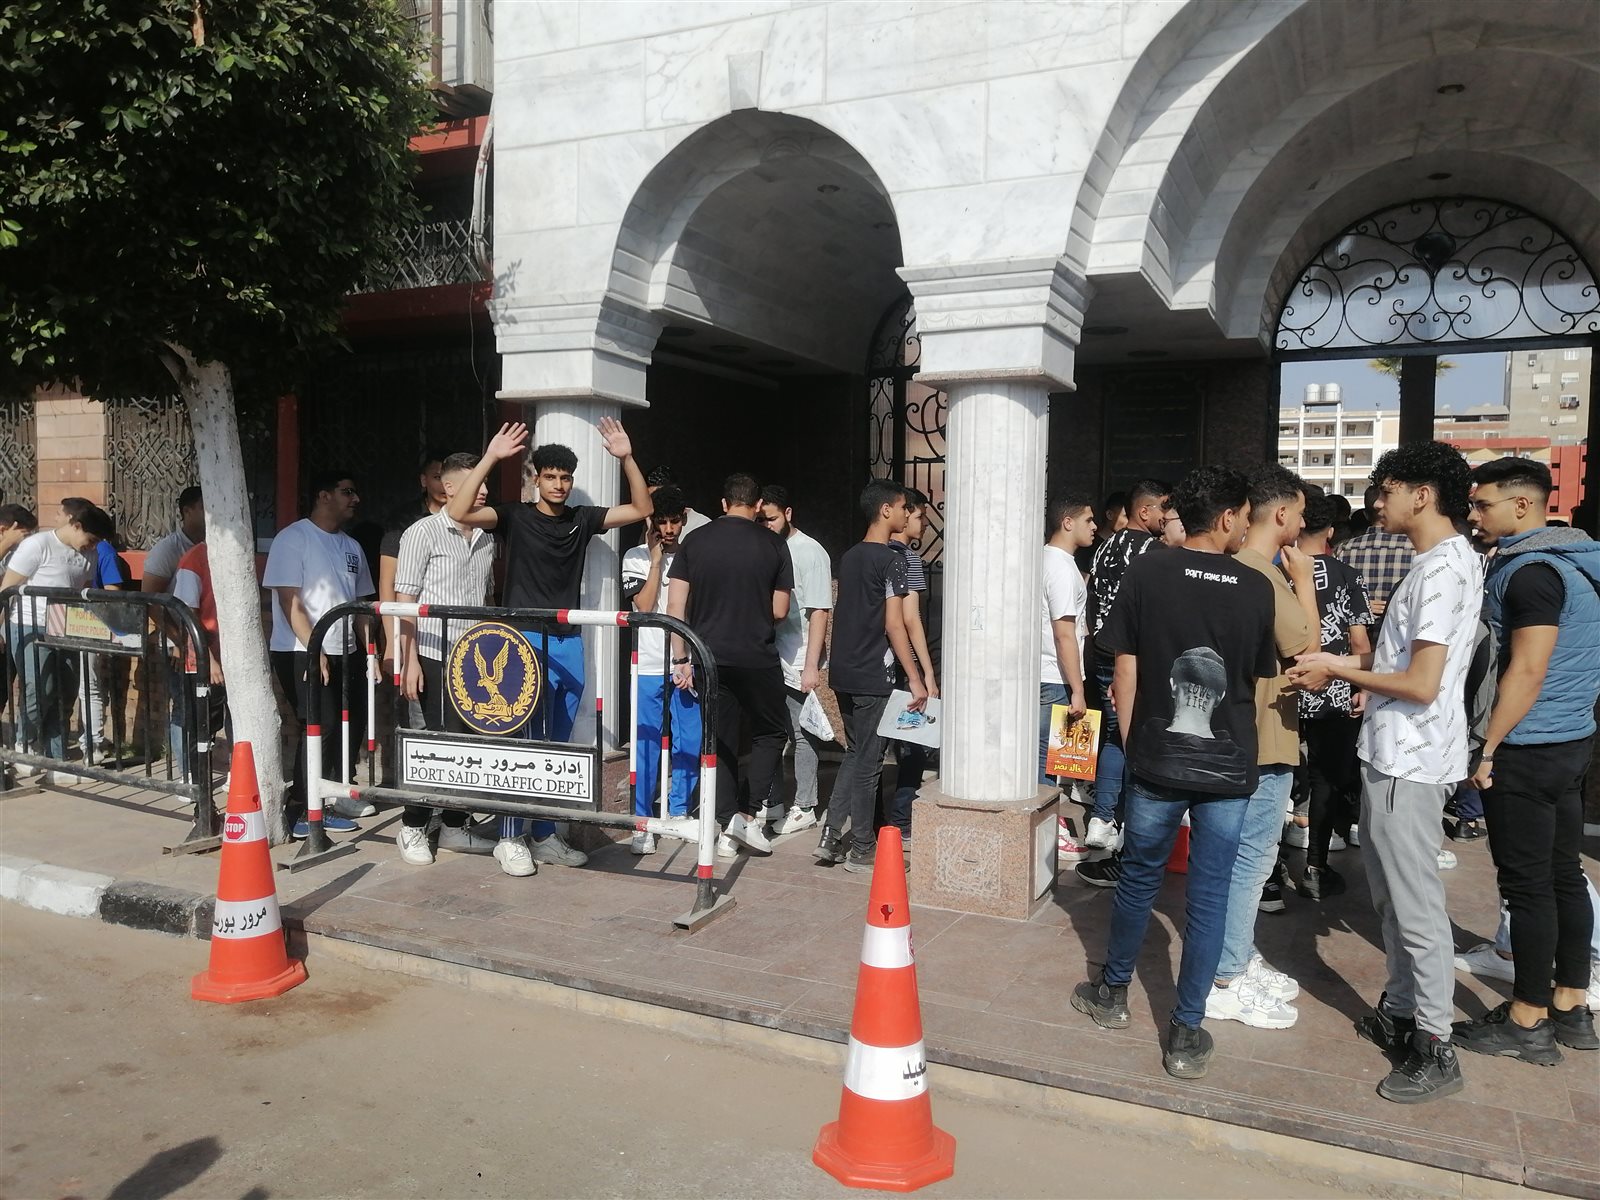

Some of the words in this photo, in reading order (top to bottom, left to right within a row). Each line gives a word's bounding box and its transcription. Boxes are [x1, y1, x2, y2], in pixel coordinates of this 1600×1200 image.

[1204, 572, 1220, 582] COME
[1221, 574, 1238, 584] BACK
[1420, 591, 1442, 608] ASSWORD
[1404, 741, 1432, 755] PASSWORD
[410, 749, 483, 770] بورسعيد
[489, 757, 536, 771] مرور
[544, 758, 583, 779] إدارة
[410, 766, 445, 781] PORT
[448, 769, 480, 784] SAID
[484, 772, 543, 791] TRAFFIC
[546, 779, 587, 795] DEPT.
[225, 822, 244, 833] STOP
[240, 906, 267, 931] مرور
